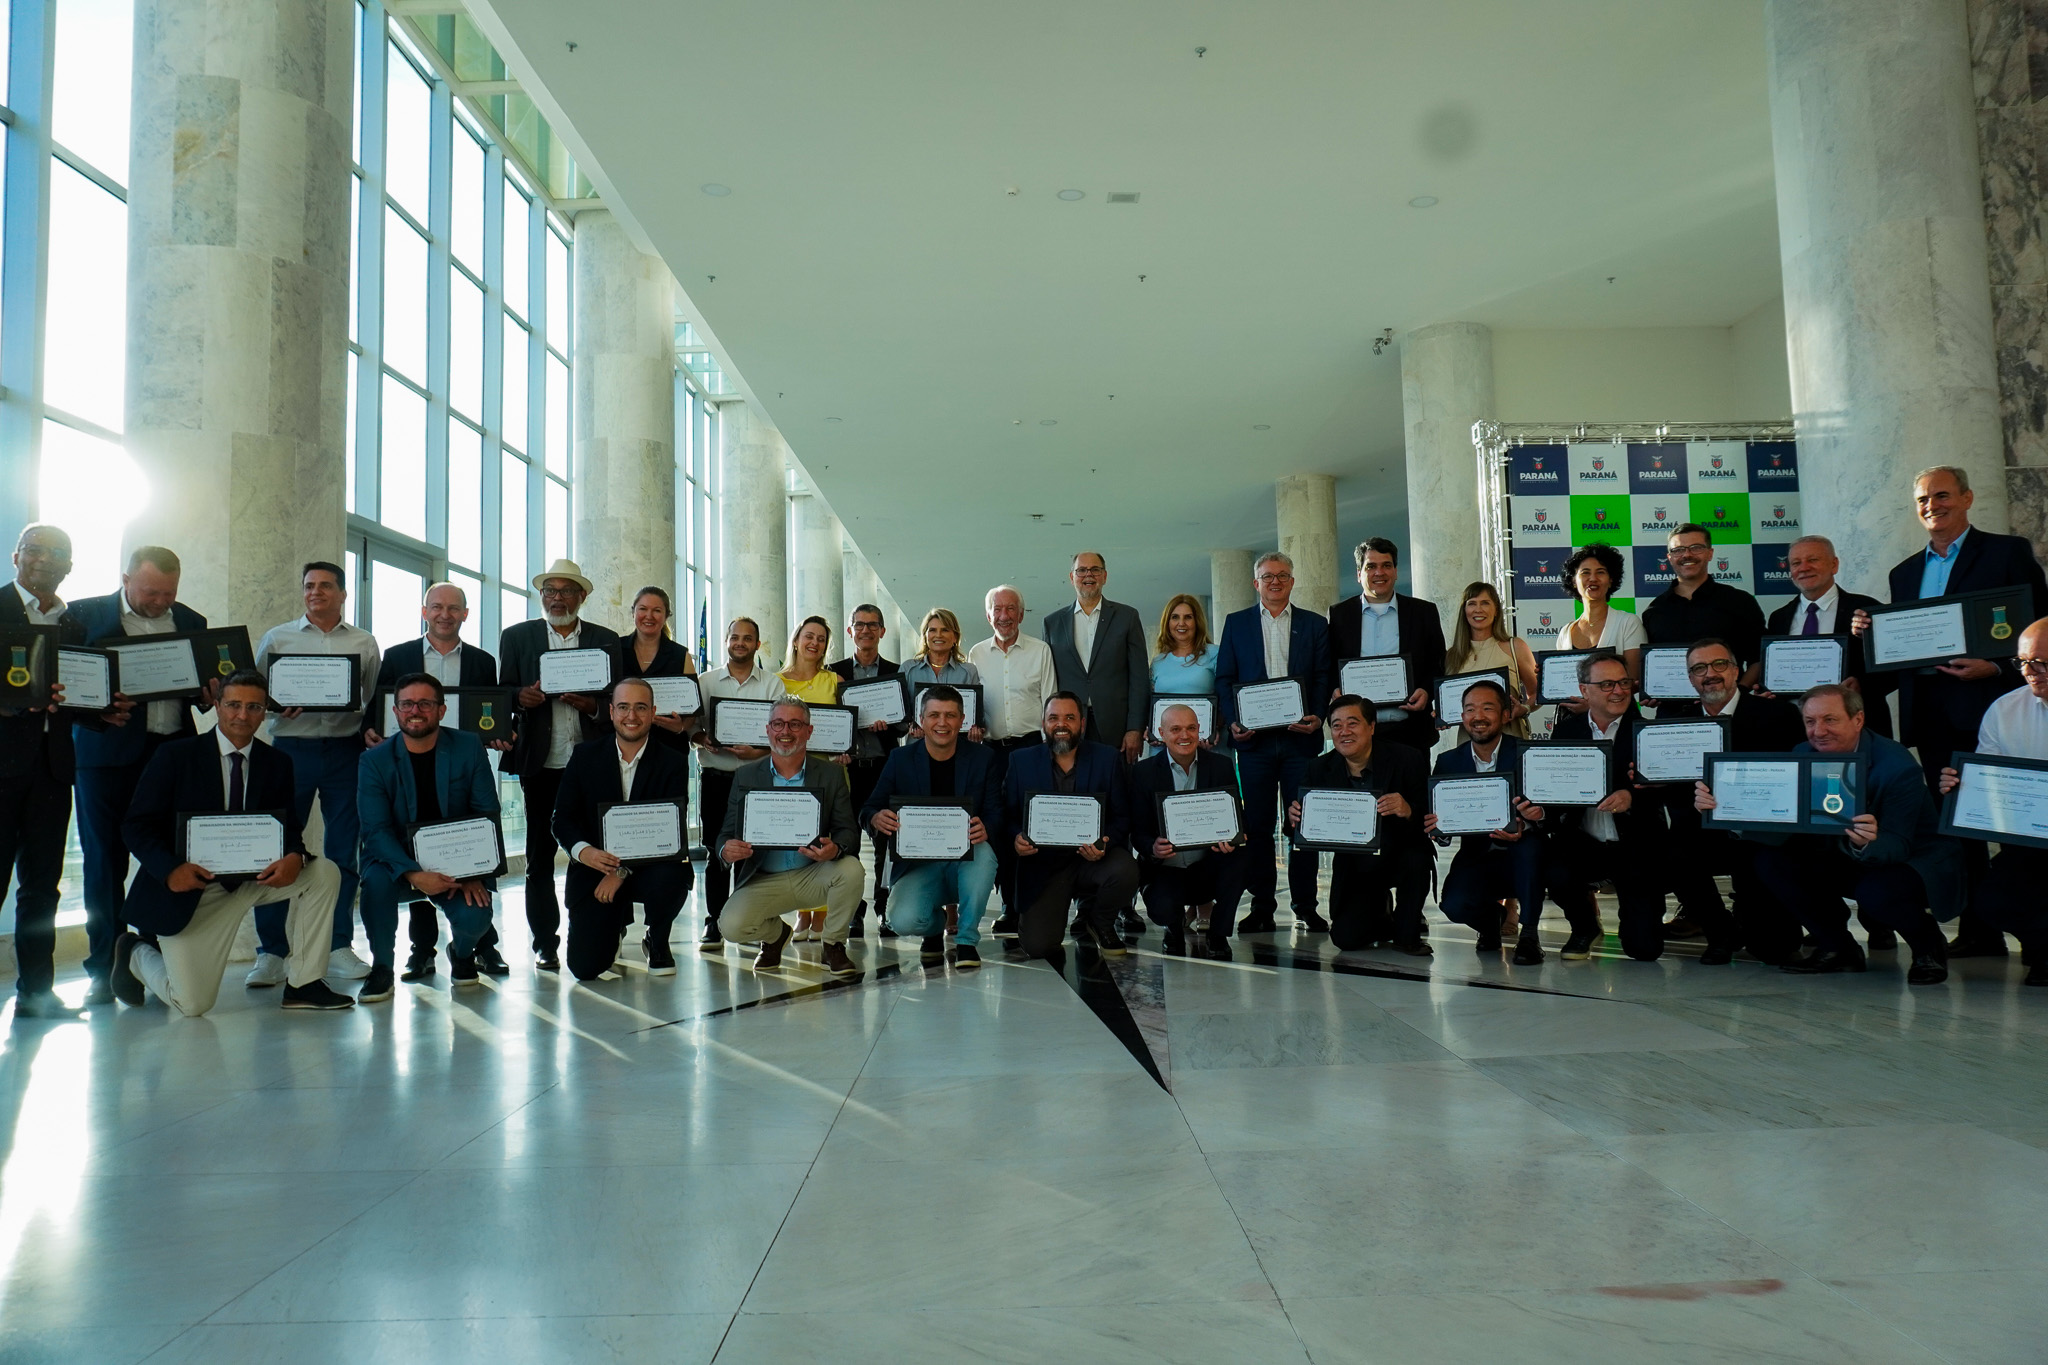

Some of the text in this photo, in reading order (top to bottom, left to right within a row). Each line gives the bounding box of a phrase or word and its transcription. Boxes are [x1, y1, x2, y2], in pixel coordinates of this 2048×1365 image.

[1520, 471, 1558, 480] PARANÁ
[1639, 470, 1677, 478] PARANÁ
[1698, 469, 1736, 477] PARANÁ
[1644, 573, 1676, 581] PARAN
[1710, 571, 1742, 579] ARANÁ
[1764, 571, 1792, 579] PARA
[1526, 627, 1562, 635] PARAN
